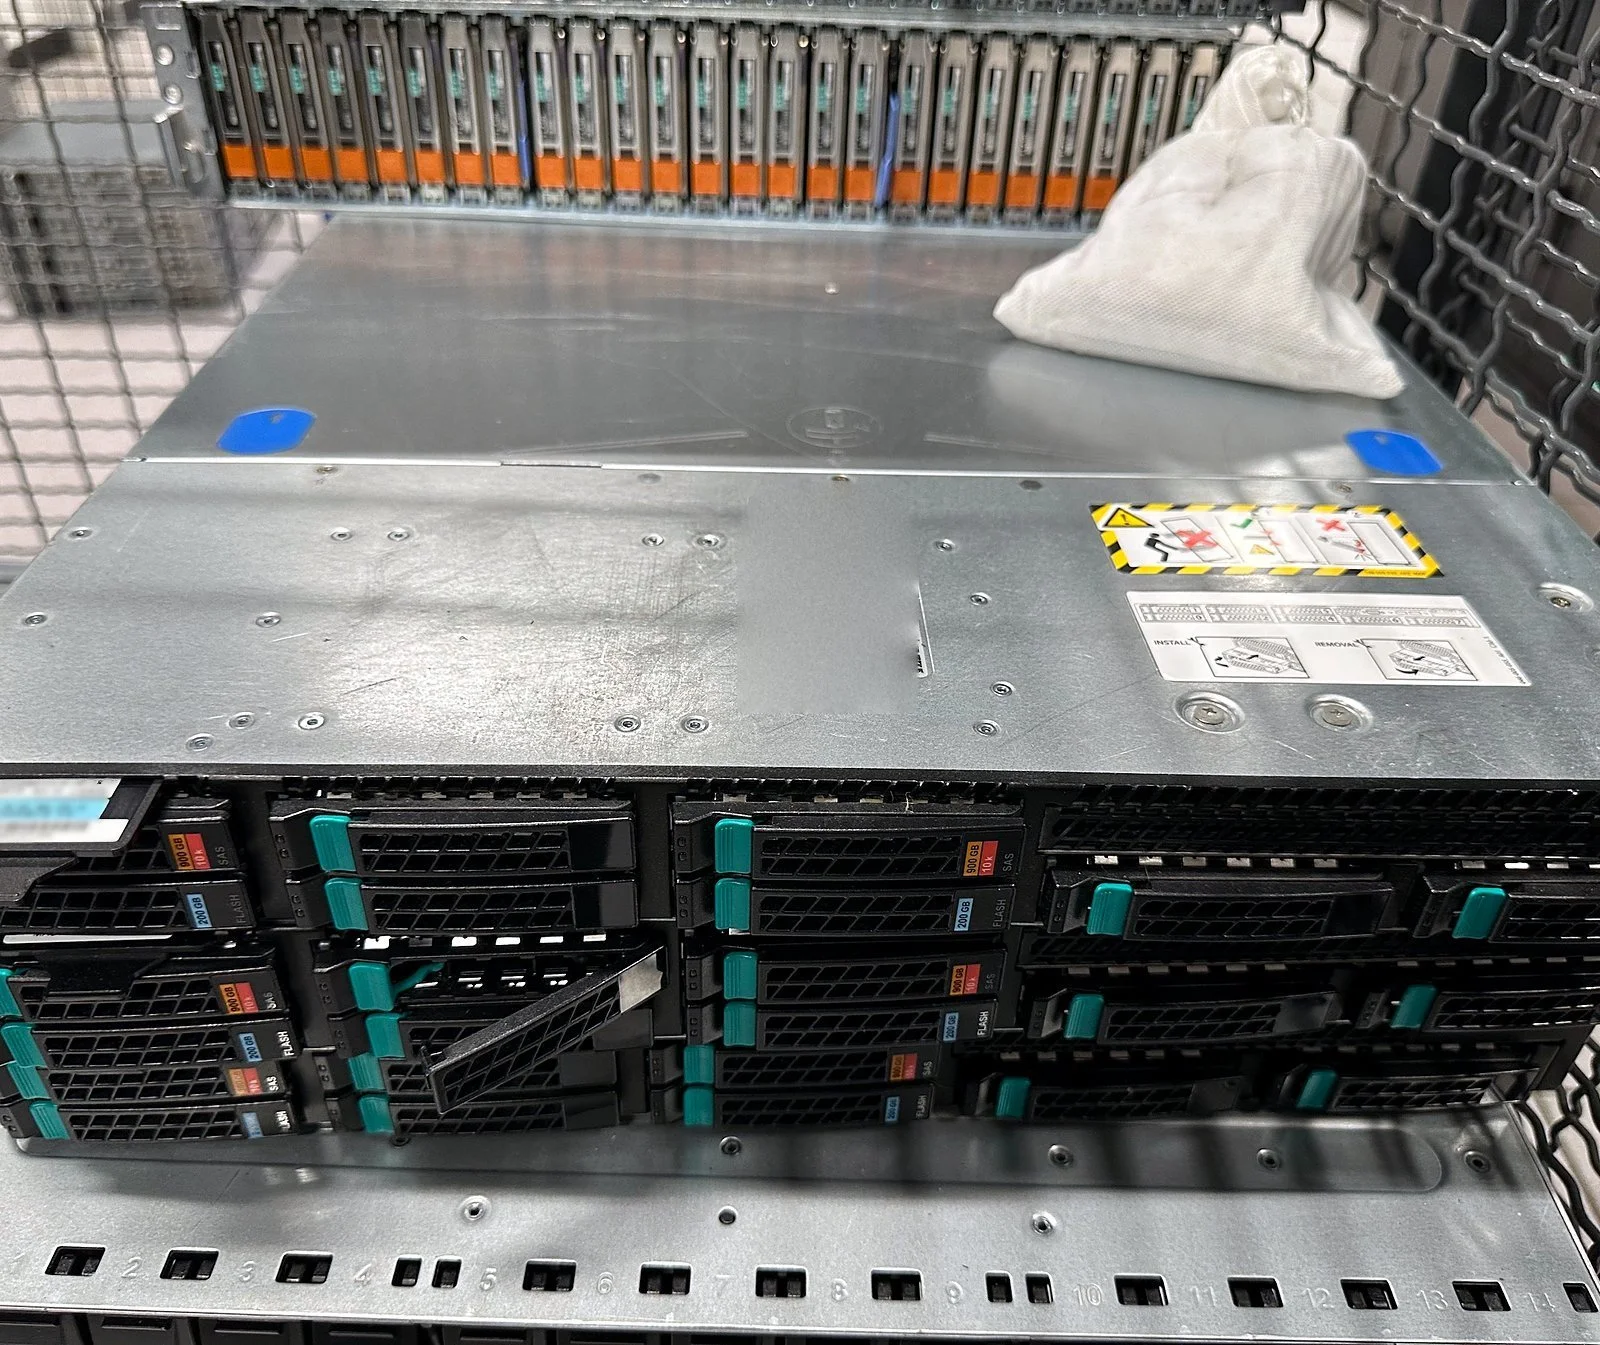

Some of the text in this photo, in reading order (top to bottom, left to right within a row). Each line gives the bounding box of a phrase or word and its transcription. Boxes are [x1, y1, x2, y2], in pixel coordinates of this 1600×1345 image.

[174, 837, 190, 867] 900 GB
[215, 846, 229, 866] SAS
[966, 844, 980, 874] 900 GB
[1002, 853, 1014, 872] SAS
[192, 897, 209, 925] 200 GB
[229, 894, 247, 924] FLASH
[957, 901, 970, 928] 200 GB
[993, 899, 1006, 927] FLASH
[952, 968, 964, 993] 900 GB
[985, 973, 996, 990] SAS
[224, 986, 240, 1012] 900 GB
[263, 992, 277, 1009] SAS
[946, 1015, 956, 1038] 200 GB
[977, 1010, 989, 1036] FLASH
[243, 1035, 259, 1059] 200 GB
[277, 1031, 294, 1056] FLASH
[922, 1061, 933, 1076] SAS
[266, 1075, 279, 1091] SAS
[916, 1095, 927, 1119] FLASH
[121, 1256, 143, 1279] 2
[239, 1261, 255, 1282] 3
[354, 1263, 372, 1286] 4
[479, 1267, 497, 1291] 5
[597, 1271, 613, 1294] 6
[715, 1274, 734, 1298] 7
[831, 1278, 848, 1300] 8
[946, 1280, 963, 1303] 9
[1072, 1282, 1103, 1306] 10
[1189, 1285, 1218, 1307] 11
[1300, 1287, 1335, 1308] 12
[1416, 1289, 1449, 1312] 13
[1523, 1292, 1557, 1312] 14
